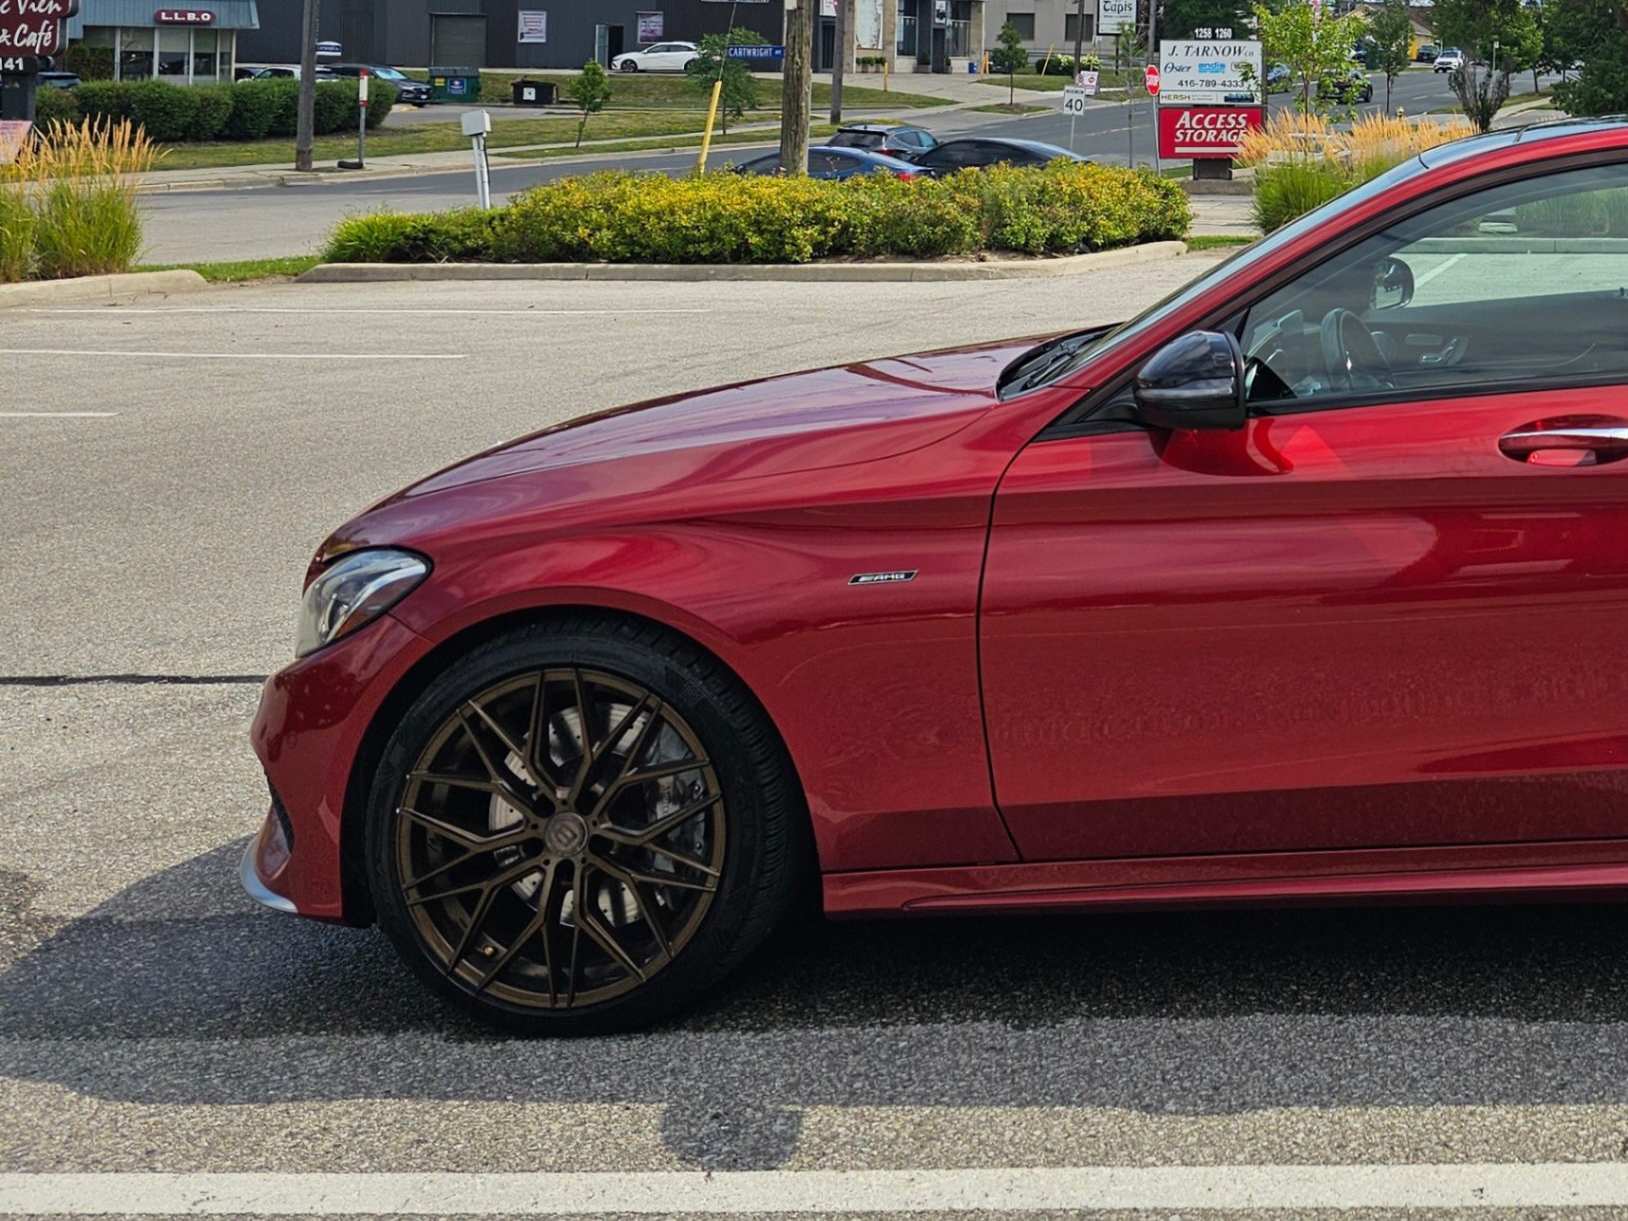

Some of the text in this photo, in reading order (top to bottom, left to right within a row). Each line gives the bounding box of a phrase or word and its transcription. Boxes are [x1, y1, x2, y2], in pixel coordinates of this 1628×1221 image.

[1103, 0, 1133, 14] Tapis
[13, 19, 53, 55] Café
[1194, 27, 1233, 39] 1258 1260
[728, 47, 773, 57] CARTWRIGHT
[1168, 45, 1179, 57] J.
[1184, 45, 1247, 57] TARNOW
[1163, 61, 1192, 74] Oster
[1178, 80, 1245, 88] 416-789-4333
[1065, 98, 1083, 112] 40
[1175, 110, 1248, 129] ACCESS
